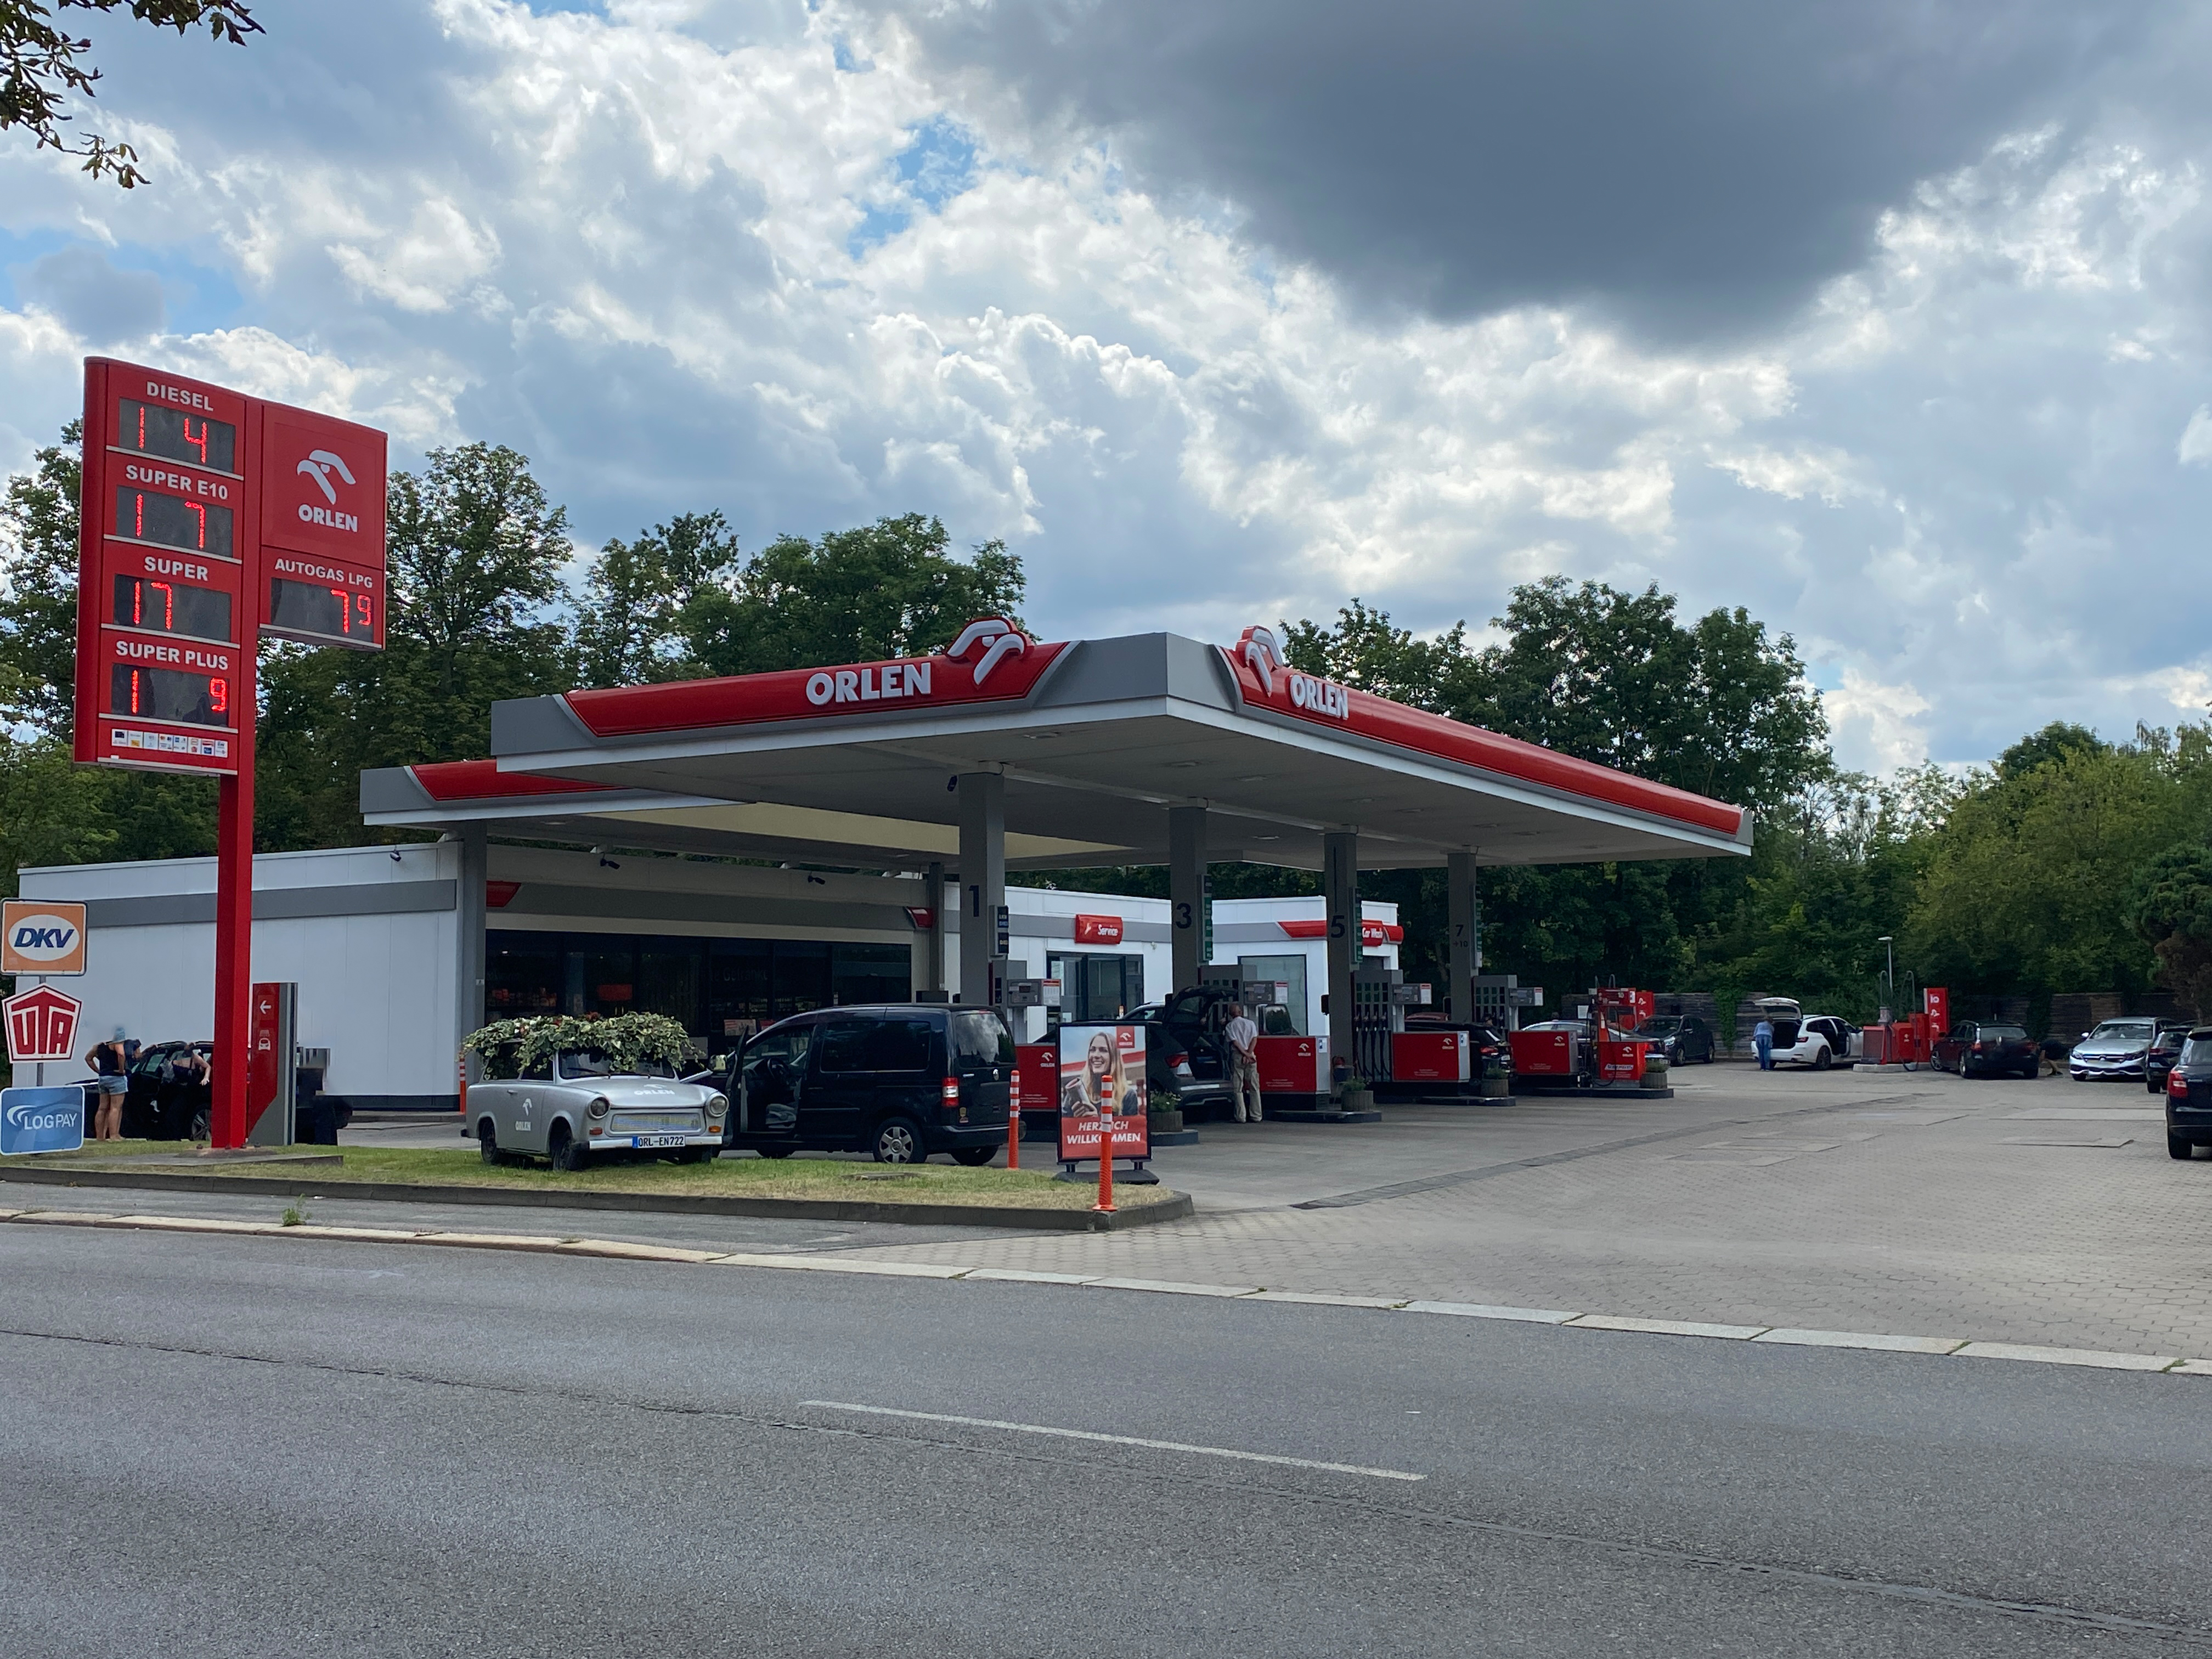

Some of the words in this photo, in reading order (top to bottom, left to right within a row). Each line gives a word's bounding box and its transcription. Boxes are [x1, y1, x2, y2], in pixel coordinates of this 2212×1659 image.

[146, 381, 214, 412] DIESEL
[126, 465, 192, 492] SUPER
[197, 478, 228, 500] E10
[297, 504, 359, 533] ORLEN
[144, 556, 208, 582] SUPER
[274, 558, 345, 583] AUTOGAS
[348, 571, 374, 589] LPG
[116, 641, 180, 664] SUPER
[185, 649, 228, 670] PLUS
[805, 662, 932, 706] ORLEN
[1290, 674, 1349, 721] ORLEN
[968, 884, 980, 918] 1
[1175, 902, 1192, 929] 3
[14, 928, 75, 949] DKV
[1097, 924, 1119, 936] Service
[1330, 915, 1345, 938] 5
[1455, 924, 1464, 937] 7
[10, 990, 77, 1056] UTA
[515, 1120, 532, 1132] ORLEN
